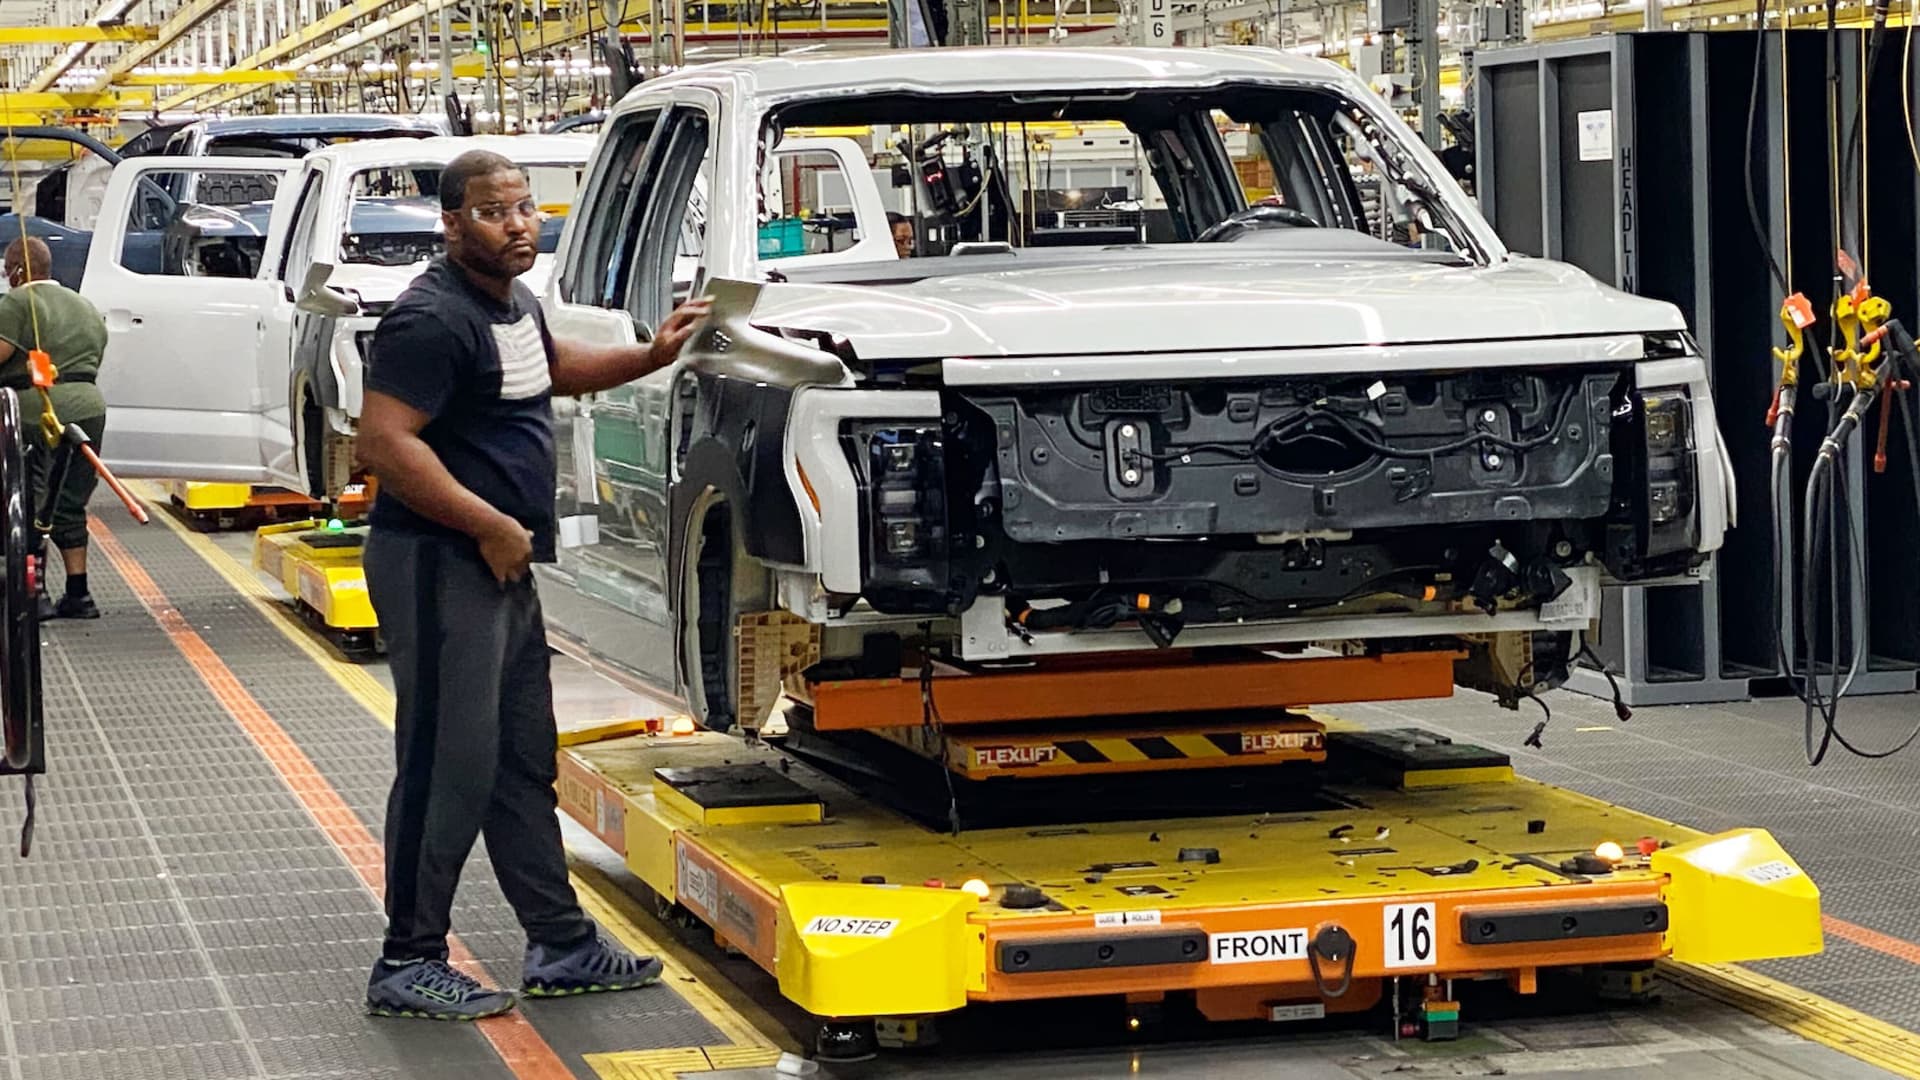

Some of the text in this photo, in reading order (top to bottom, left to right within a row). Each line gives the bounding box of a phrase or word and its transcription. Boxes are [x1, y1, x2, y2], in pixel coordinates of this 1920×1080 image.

[1153, 22, 1164, 38] 6
[1622, 148, 1633, 294] HEADLIN
[1241, 732, 1321, 752] FLEXLIFT
[976, 746, 1057, 765] FLEXLIFT
[810, 918, 892, 935] NO STEP
[1391, 907, 1431, 961] 16
[1217, 933, 1303, 959] FRONT
